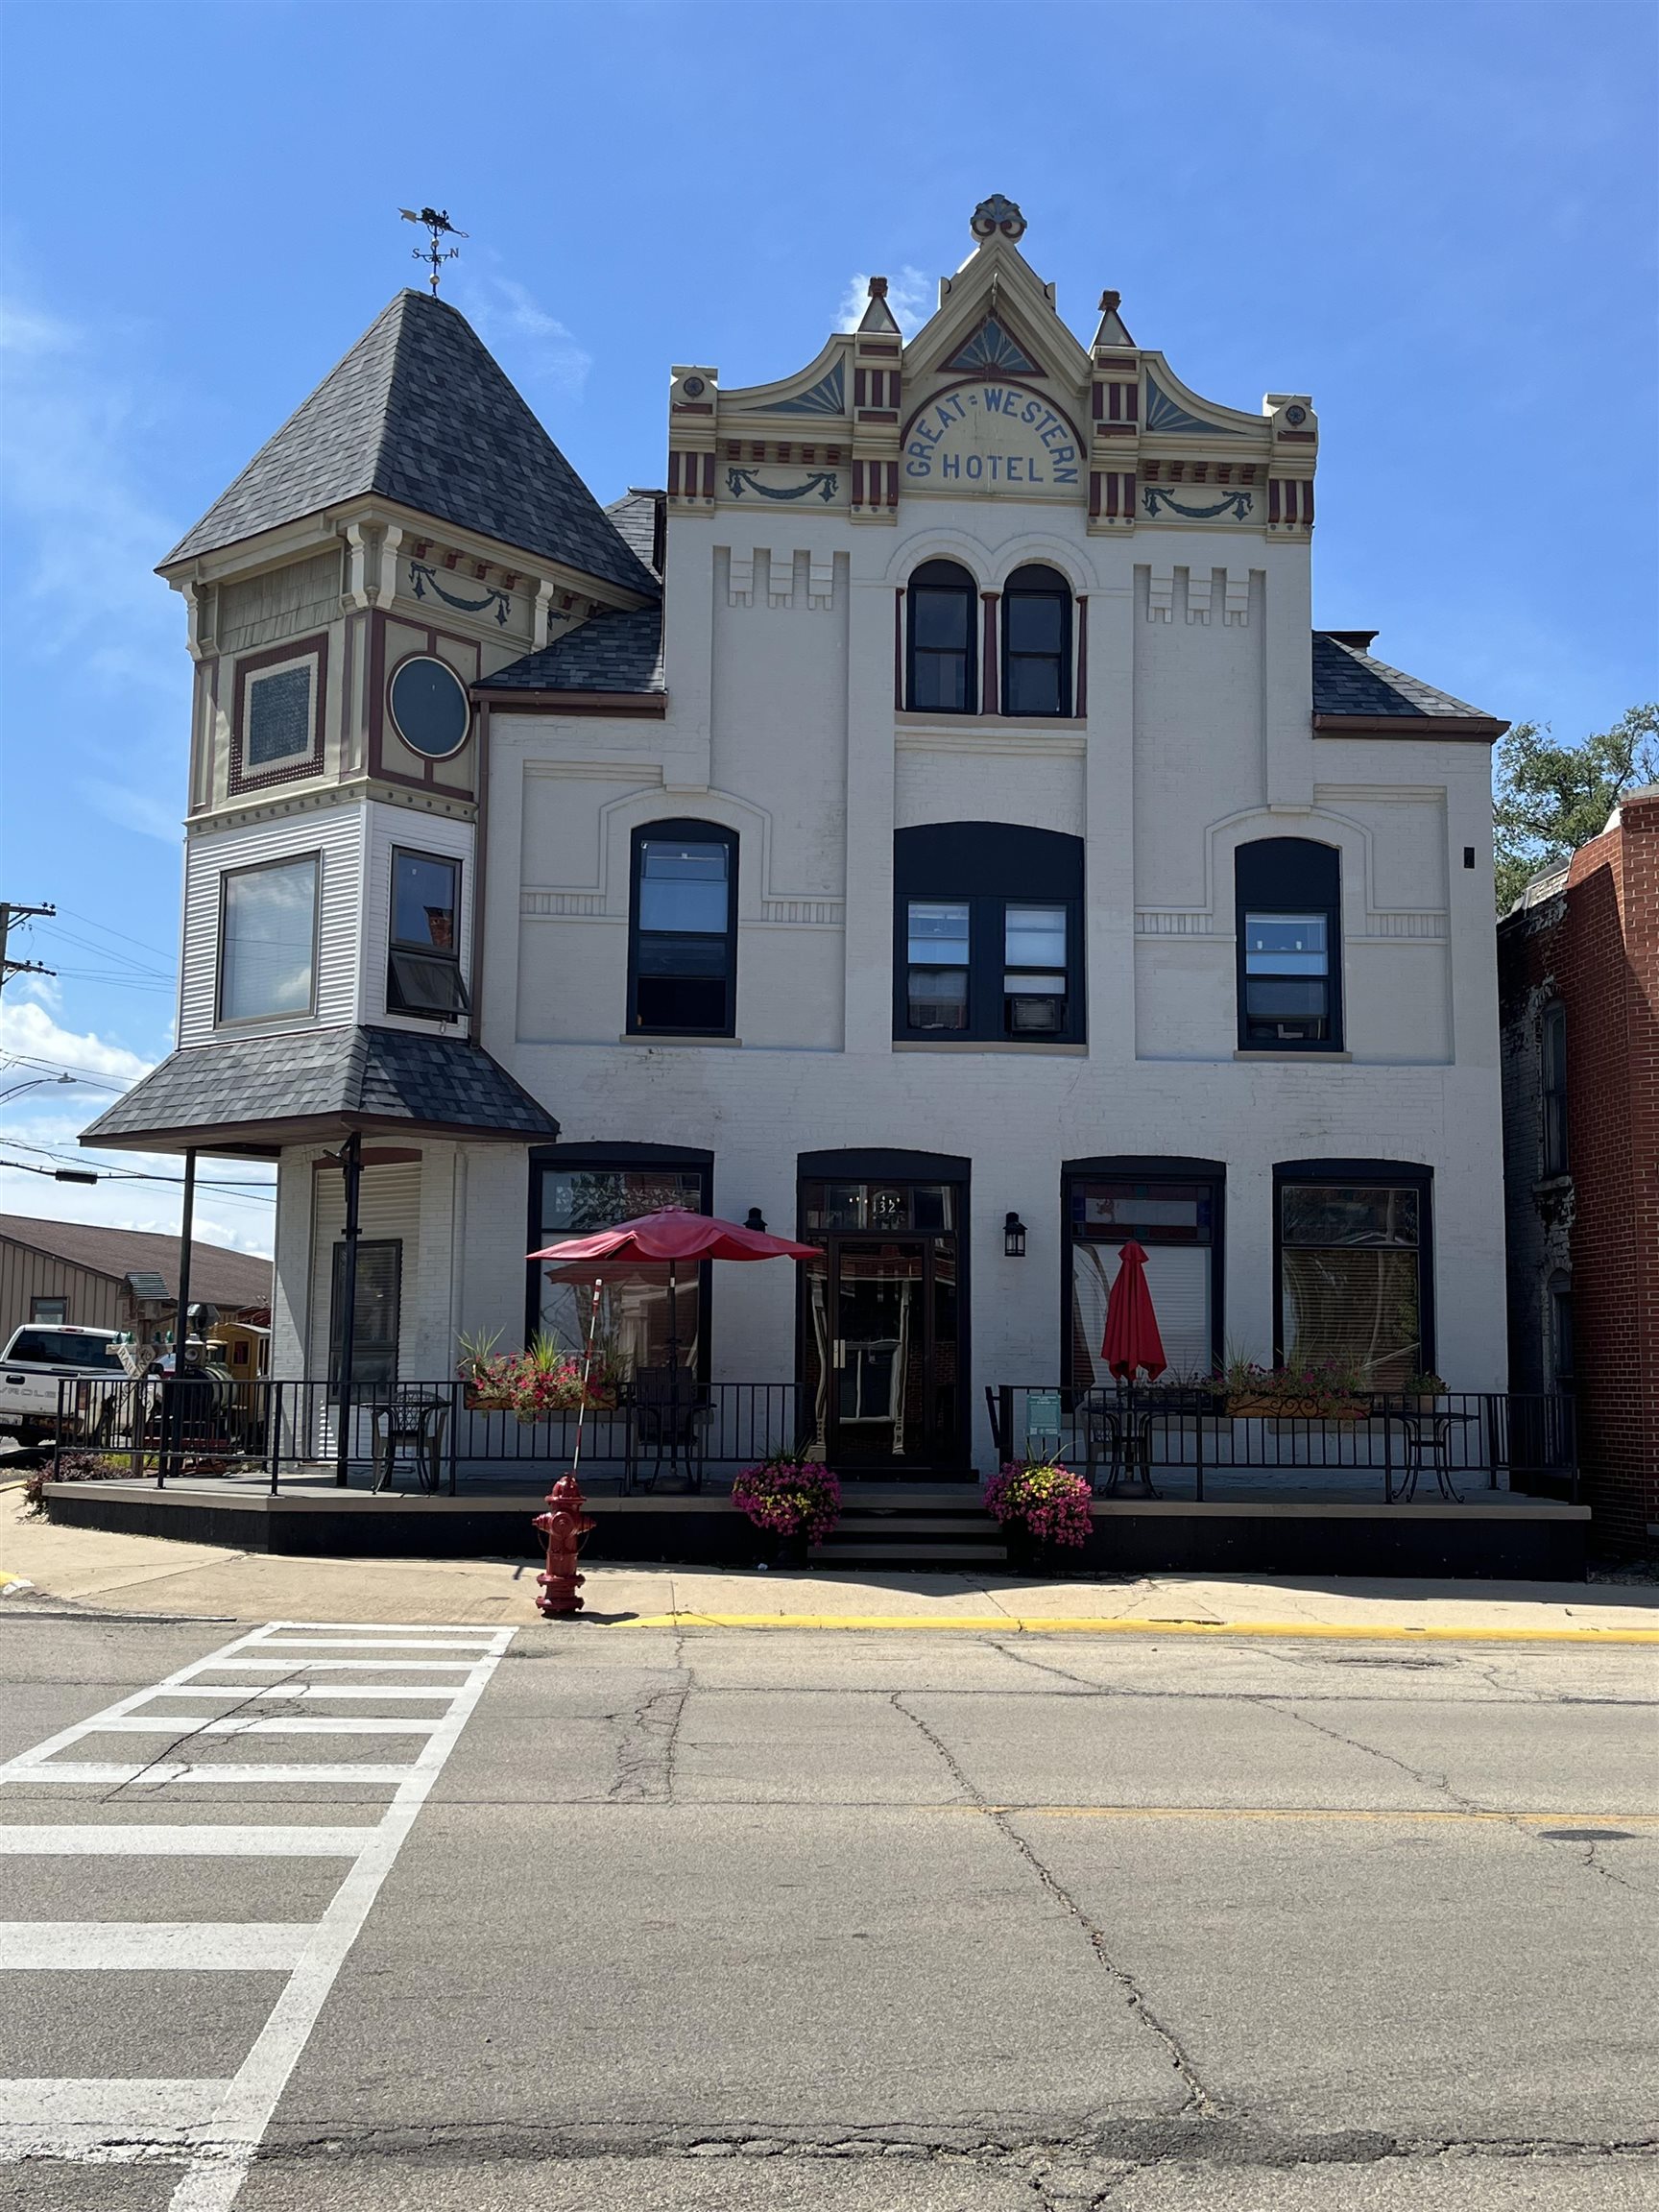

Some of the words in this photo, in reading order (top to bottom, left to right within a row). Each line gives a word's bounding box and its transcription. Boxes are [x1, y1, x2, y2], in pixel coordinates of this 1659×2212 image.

[449, 248, 459, 258] N
[906, 393, 966, 477] GREAT
[984, 388, 1078, 484] WESTERN
[943, 453, 1044, 482] HOTEL
